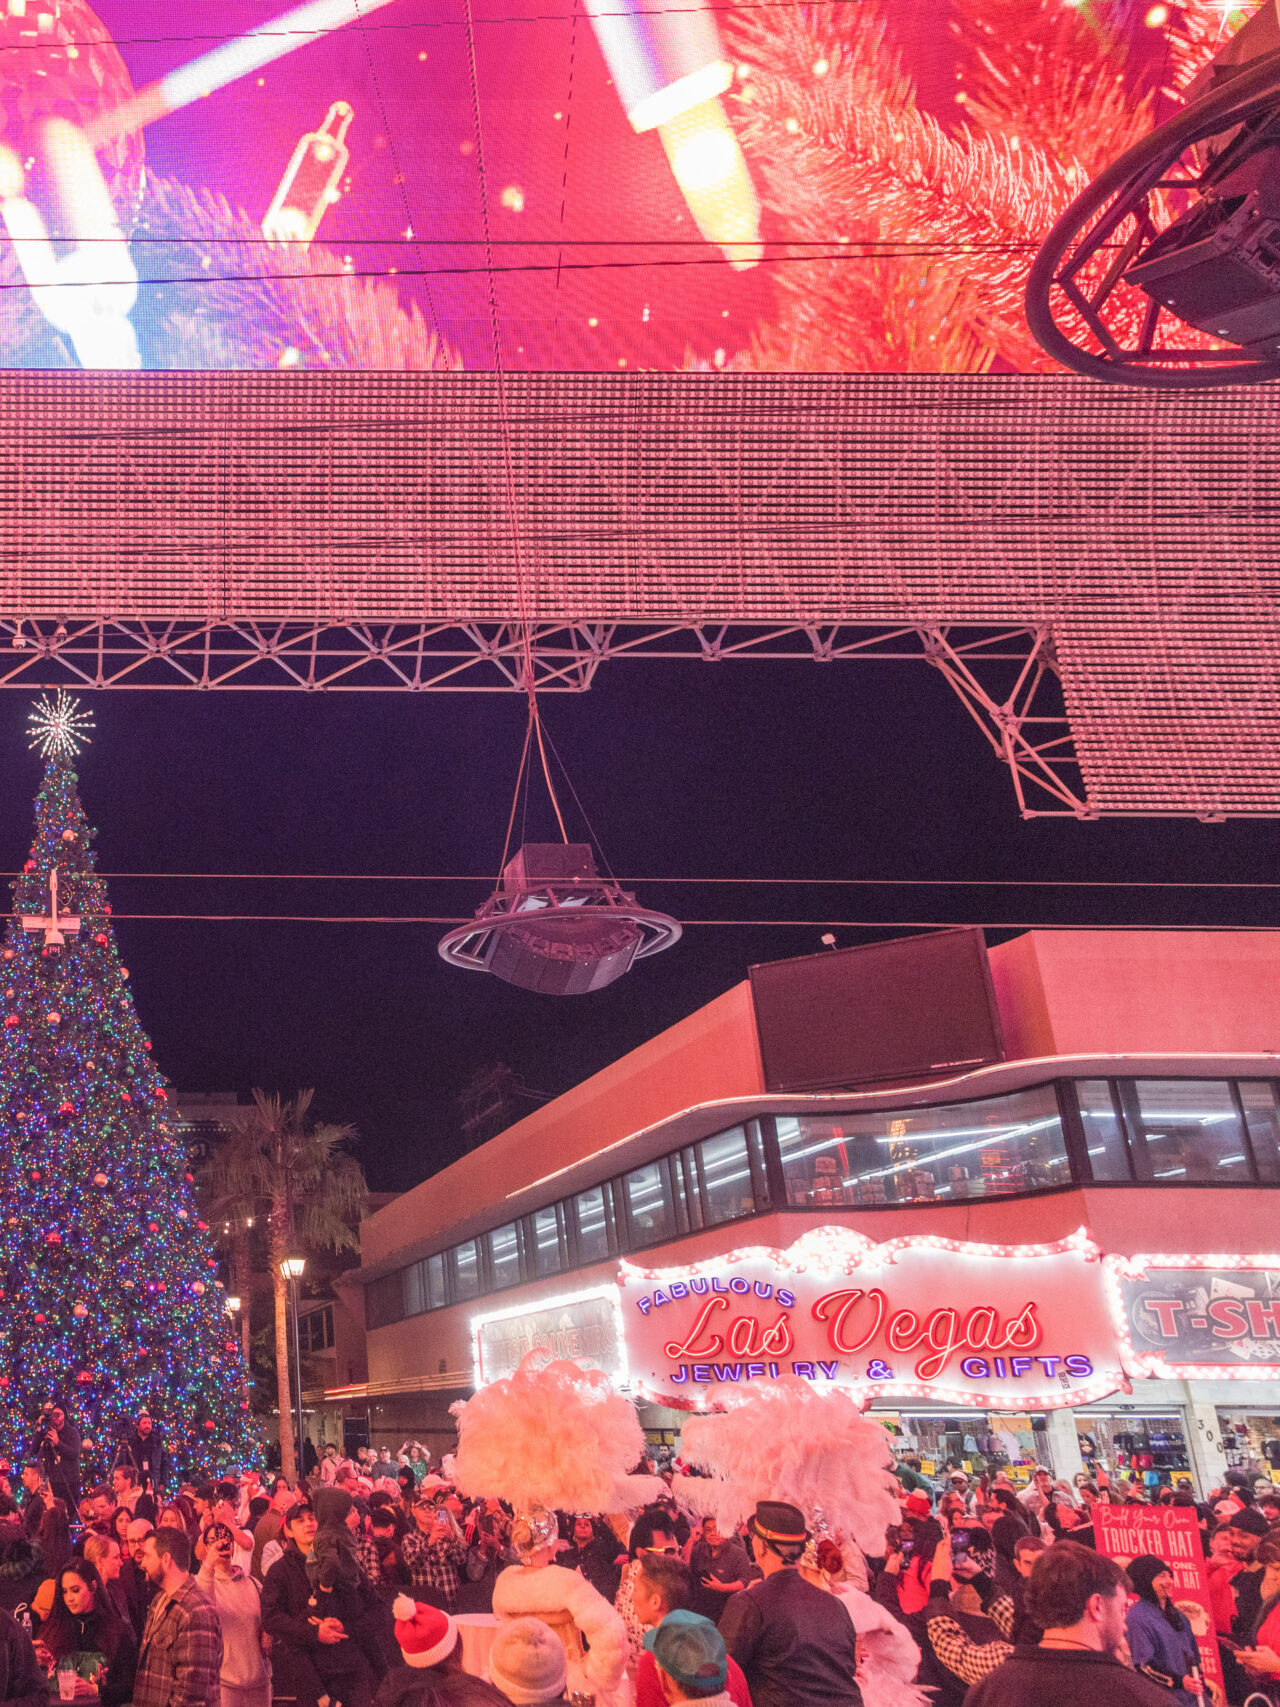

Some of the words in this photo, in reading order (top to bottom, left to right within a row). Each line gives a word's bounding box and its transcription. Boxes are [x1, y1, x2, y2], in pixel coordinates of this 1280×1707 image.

[638, 1276, 796, 1315] FABULOUS
[664, 1296, 795, 1359] Las
[812, 1288, 1043, 1380] Vegas
[867, 1360, 894, 1380] &
[960, 1355, 1094, 1379] GIFTS
[1133, 1509, 1160, 1530] Your
[1163, 1510, 1189, 1529] Own
[1102, 1527, 1164, 1556] TRUCKER
[1167, 1531, 1195, 1558] HAT
[1172, 1561, 1197, 1571] ONE:
[1182, 1571, 1200, 1590] HAT
